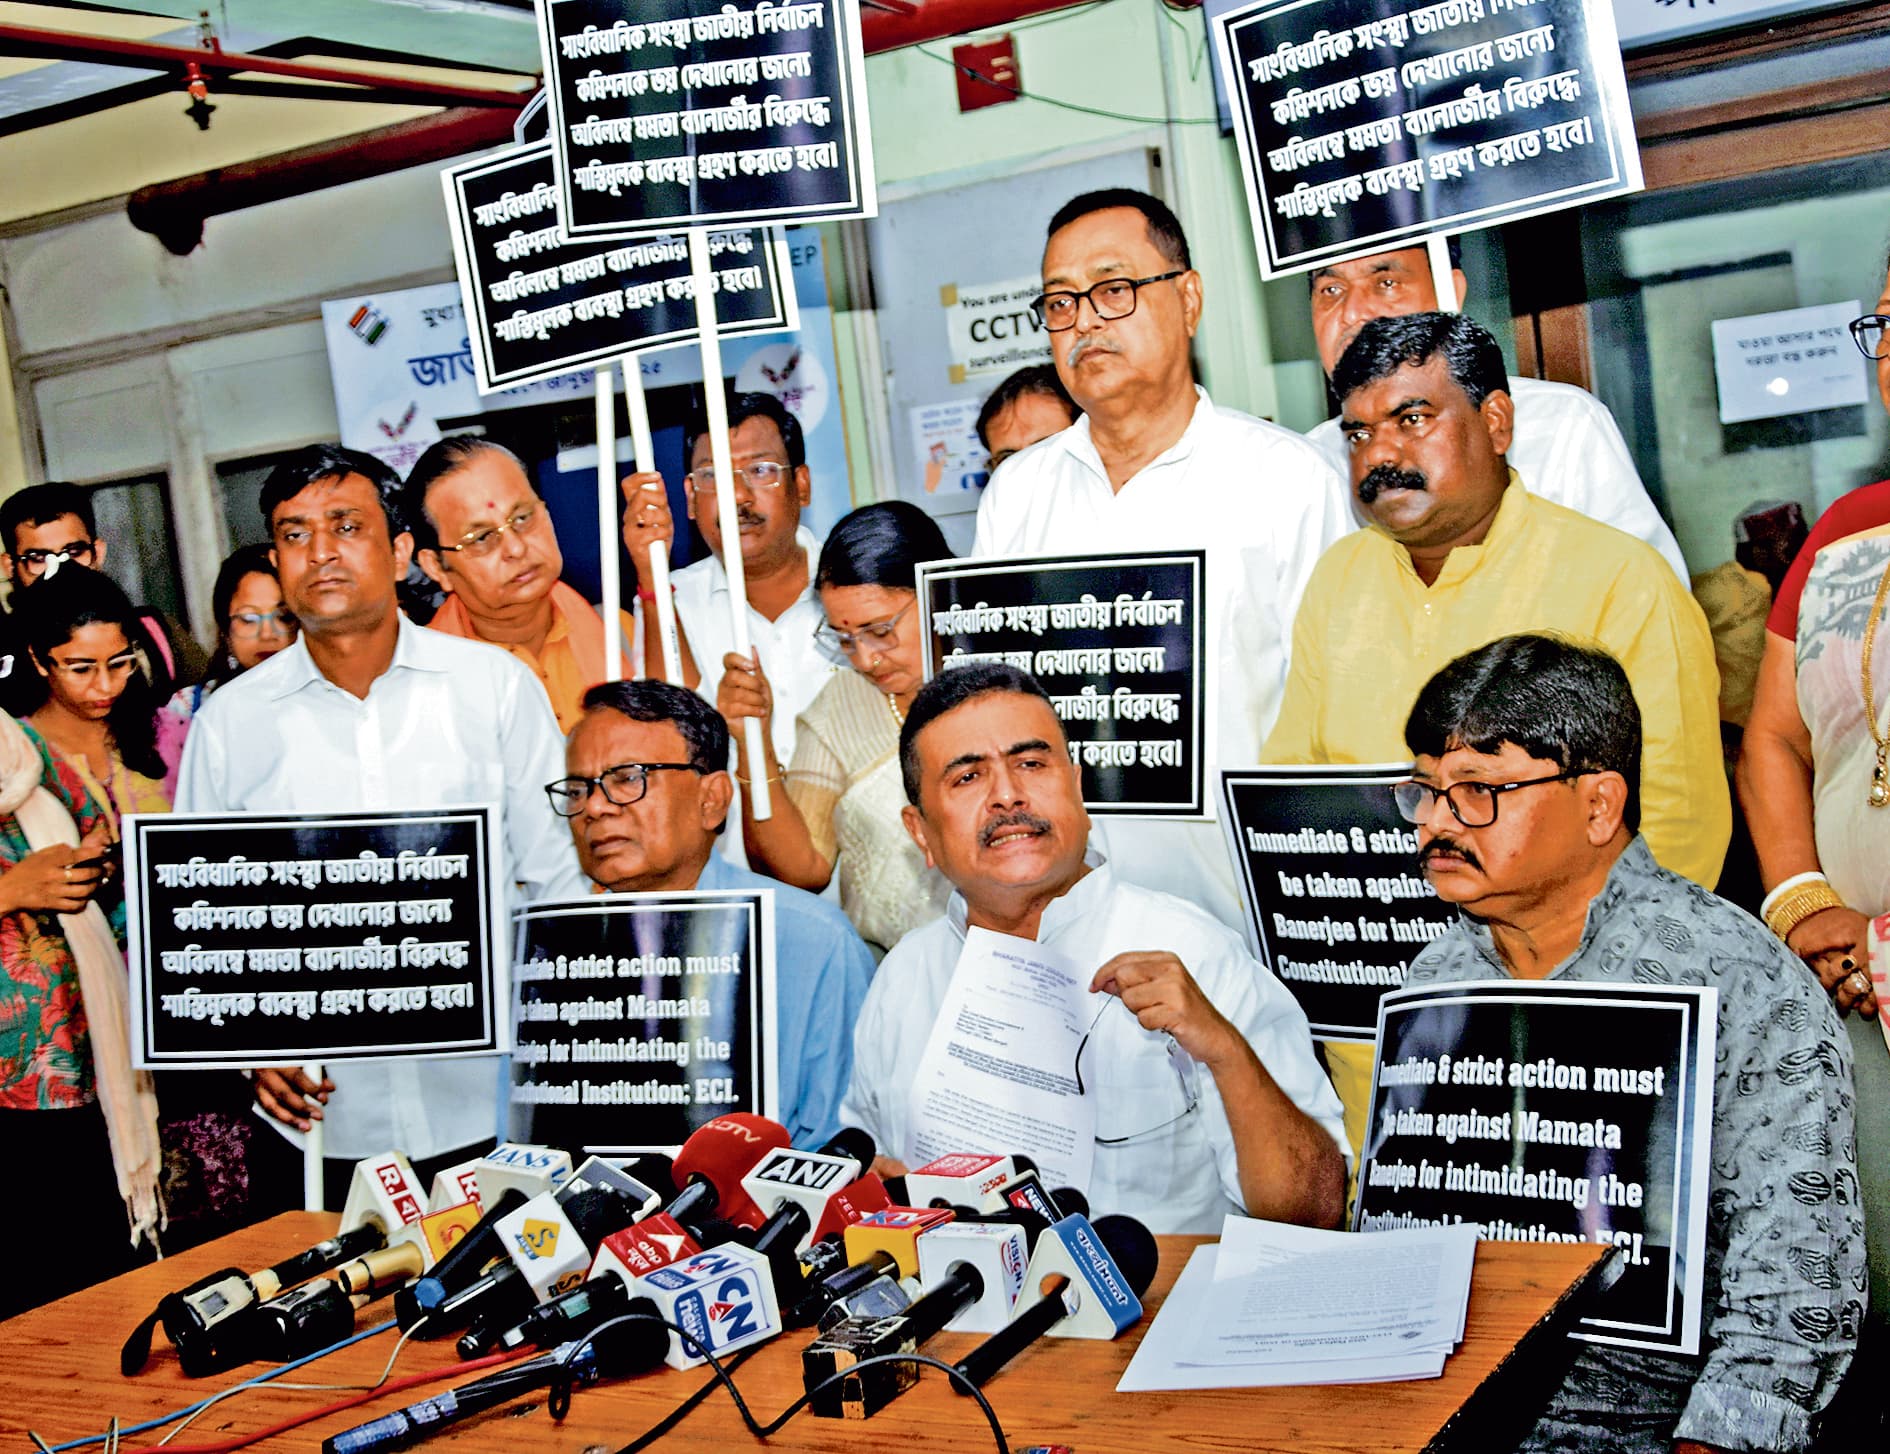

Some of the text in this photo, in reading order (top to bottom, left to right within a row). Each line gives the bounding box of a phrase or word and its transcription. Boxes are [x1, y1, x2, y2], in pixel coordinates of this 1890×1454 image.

[560, 0, 825, 60] সাংবিধানিক সংস্থা জাতীয় নির্বাচন
[1248, 30, 1354, 85] সাংবিধানিক
[1354, 16, 1409, 49] সংস্থা
[575, 51, 812, 102] কমিশনকে ভয় দেখানোর জন্যে
[1270, 24, 1556, 126] কমিশনকে ভয় দেখানোর জন্যে
[570, 94, 832, 147] অবিলম্বে মমতা ব্যানার্জীর বিরুদ্ধে
[1267, 69, 1582, 173] অবিলম্বে মমতা ব্যানার্জীর বিরুদ্ধে
[573, 141, 838, 197] শাস্তিমূলক ব্যবস্থা গ্রহণ করতে হবে।
[1274, 116, 1595, 220] শাস্তিমূলক ব্যবস্থা গ্রহণ করতে হবে।
[489, 267, 560, 302] অবিলম্বে
[560, 254, 606, 285] মমতা
[1013, 286, 1043, 301] unde
[494, 304, 573, 340] শাস্তিমূলক
[572, 288, 624, 321] ব্যবস্থা
[625, 280, 665, 311] গ্রহণ
[933, 590, 1184, 636] সাংবিধানিক সংস্থা জাতীয় নির্বাচন
[1035, 648, 1111, 676] দেখানোর
[1113, 646, 1166, 673] জন্যে
[1112, 686, 1181, 723] বিরুদ্ধে
[1082, 740, 1138, 767] করতে
[1139, 739, 1182, 767] হবে।
[1246, 826, 1349, 854] Immediate
[1350, 826, 1367, 853] &
[155, 847, 469, 889] সাংবিধানিক সংস্থা জাতীয় নির্বাচন
[1277, 870, 1437, 904] be taken agains
[172, 898, 453, 931] কমিশনকে ভয় দেখানোর জন্যে
[1273, 913, 1356, 946] Banerjee
[1358, 916, 1388, 941] for
[160, 936, 470, 975] অবিলম্বে মমতা ব্যানার্জীর বিরুদ্ধে
[569, 954, 614, 978] strict
[617, 952, 681, 978] action
[686, 952, 741, 976] must
[1277, 954, 1408, 985] Constitutional
[160, 981, 474, 1026] শাস্তিমূলক ব্যবস্থা গ্রহণ করতে হবে।
[559, 995, 624, 1026] against
[626, 994, 711, 1020] Mamata
[571, 1037, 690, 1067] intimidating
[696, 1036, 731, 1060] the
[694, 1078, 739, 1103] ECI.
[1437, 1054, 1451, 1085] &
[1452, 1055, 1504, 1086] strict
[1508, 1058, 1587, 1091] action
[1593, 1065, 1665, 1096] must
[1396, 1107, 1433, 1136] taken
[1436, 1108, 1511, 1145] against
[1516, 1111, 1622, 1150] Mamata
[487, 1148, 559, 1168] IANS
[760, 1157, 839, 1189] ANI
[1418, 1158, 1443, 1190] for
[1445, 1160, 1590, 1209] intimidating
[1598, 1174, 1644, 1208] the
[838, 1195, 857, 1220] ZEE
[638, 1241, 662, 1264] abp
